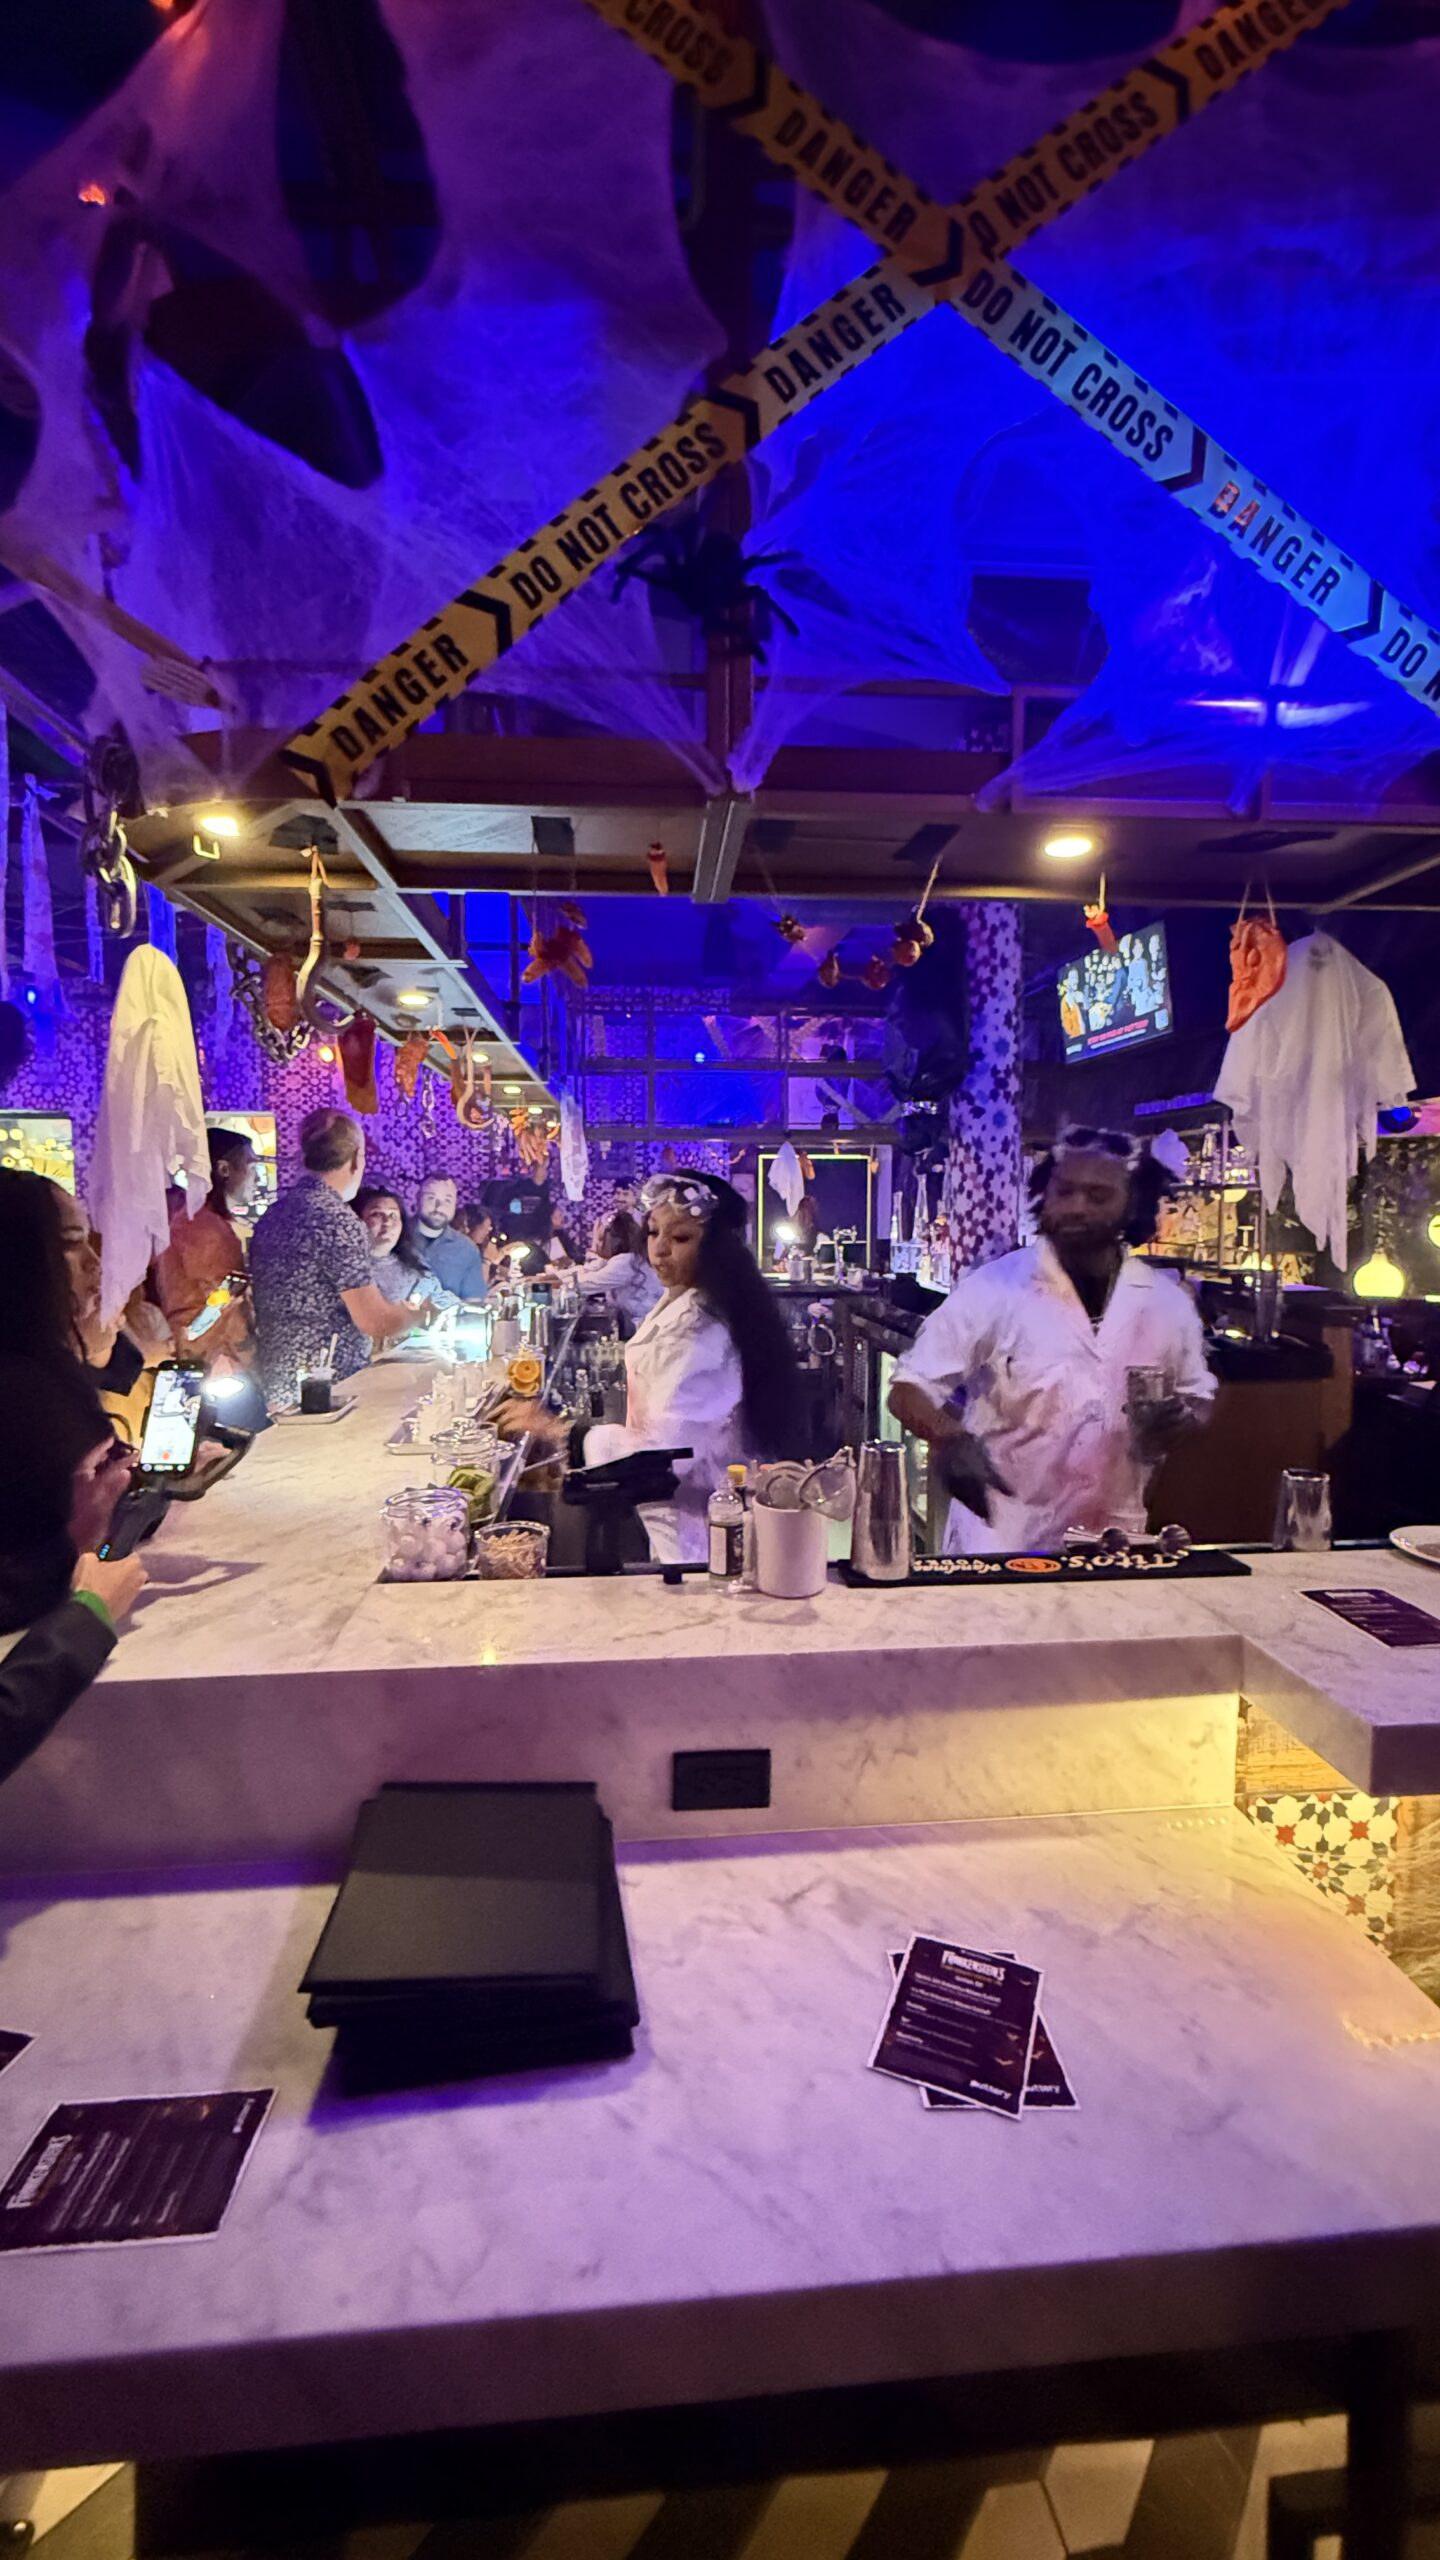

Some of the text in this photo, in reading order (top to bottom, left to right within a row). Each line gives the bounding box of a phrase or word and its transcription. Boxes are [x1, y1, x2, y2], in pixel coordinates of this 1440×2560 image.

[330, 633, 469, 762] DANGER
[508, 555, 563, 610] DO
[556, 503, 624, 572] NOT
[620, 422, 727, 520] CROSS
[764, 283, 906, 403] DANGER
[994, 165, 1060, 230] NOT
[1057, 91, 1158, 183] CROSS
[1194, 0, 1321, 81] DANGE
[775, 109, 918, 242] DANGER
[962, 268, 1013, 325] DO
[1008, 309, 1077, 379] NOT
[1071, 362, 1175, 463] CROSS
[1207, 480, 1341, 607] DANGER
[1379, 626, 1428, 679] DO
